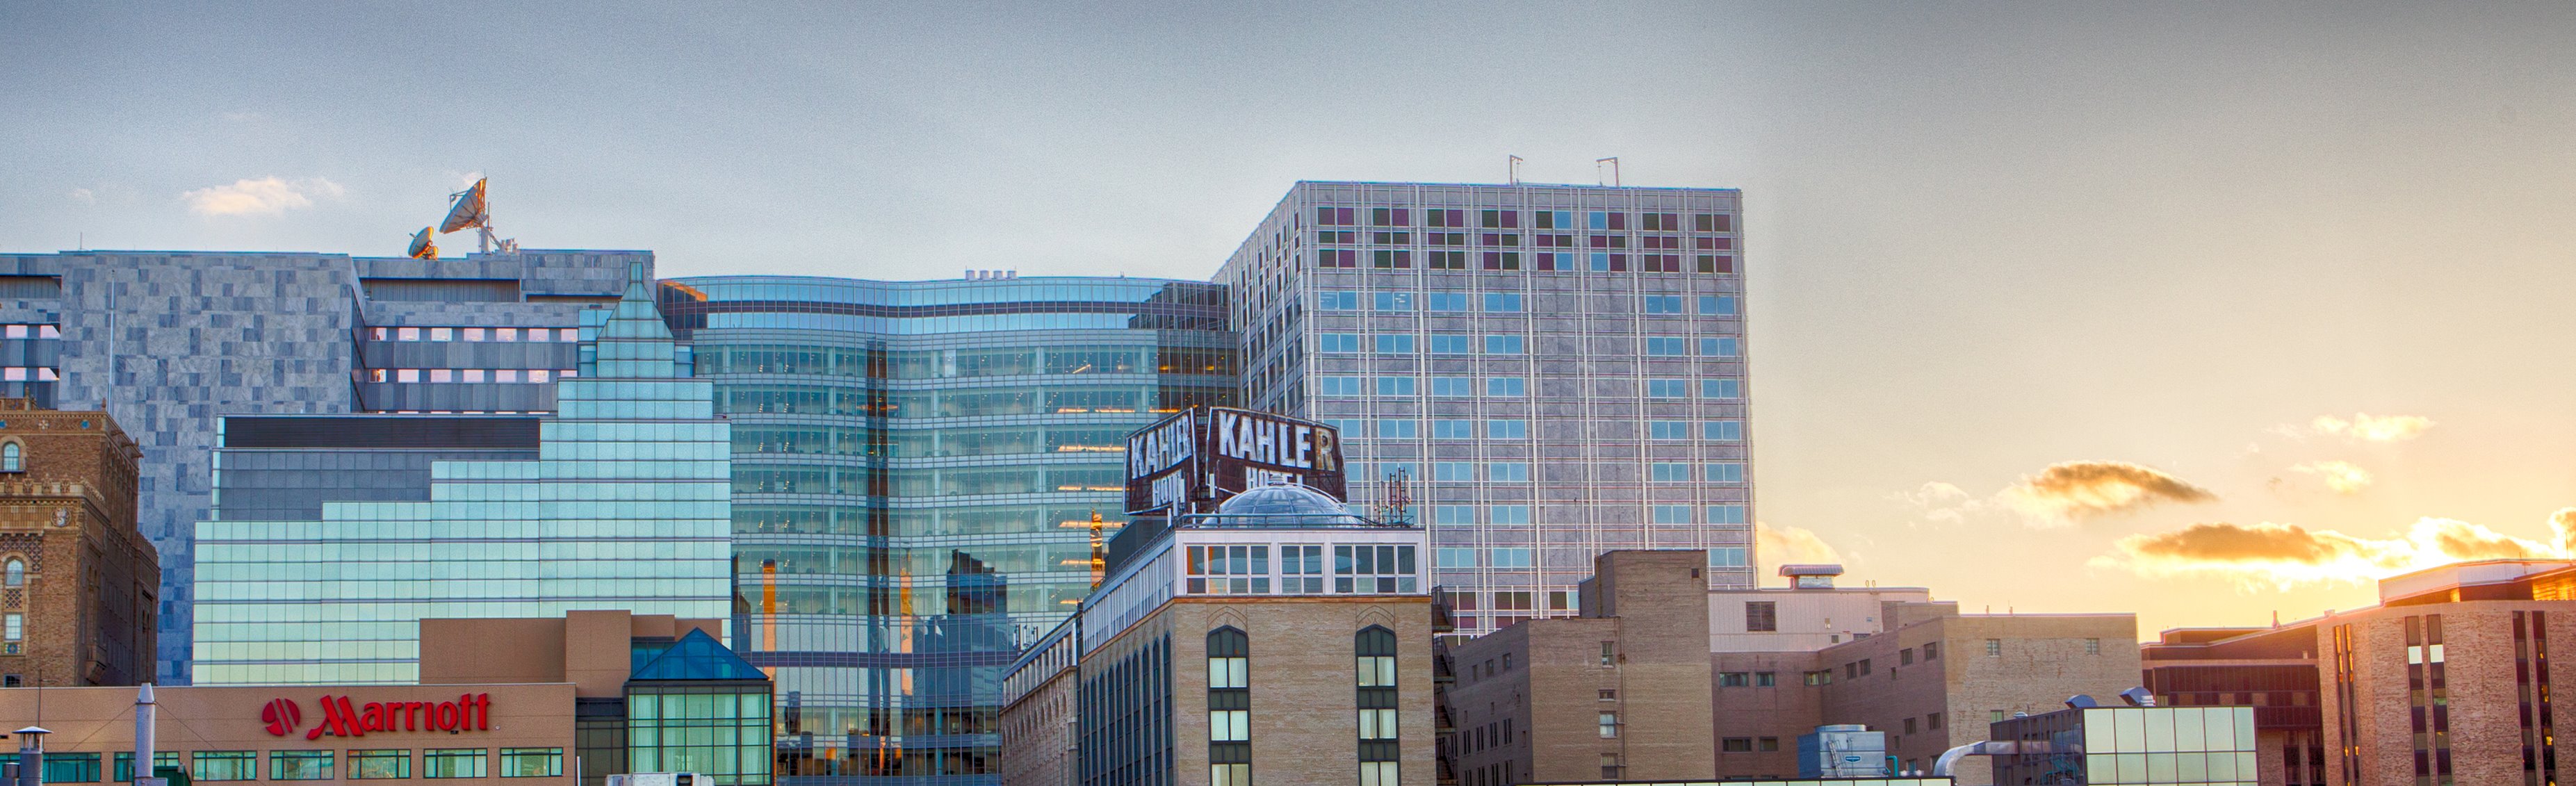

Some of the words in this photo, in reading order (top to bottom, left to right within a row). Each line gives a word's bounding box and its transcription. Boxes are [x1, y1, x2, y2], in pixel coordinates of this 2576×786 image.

[1131, 414, 1192, 480] KAHLER
[1218, 410, 1335, 472] KAHLER
[1246, 466, 1303, 490] HOE
[306, 692, 491, 740] Marriott
